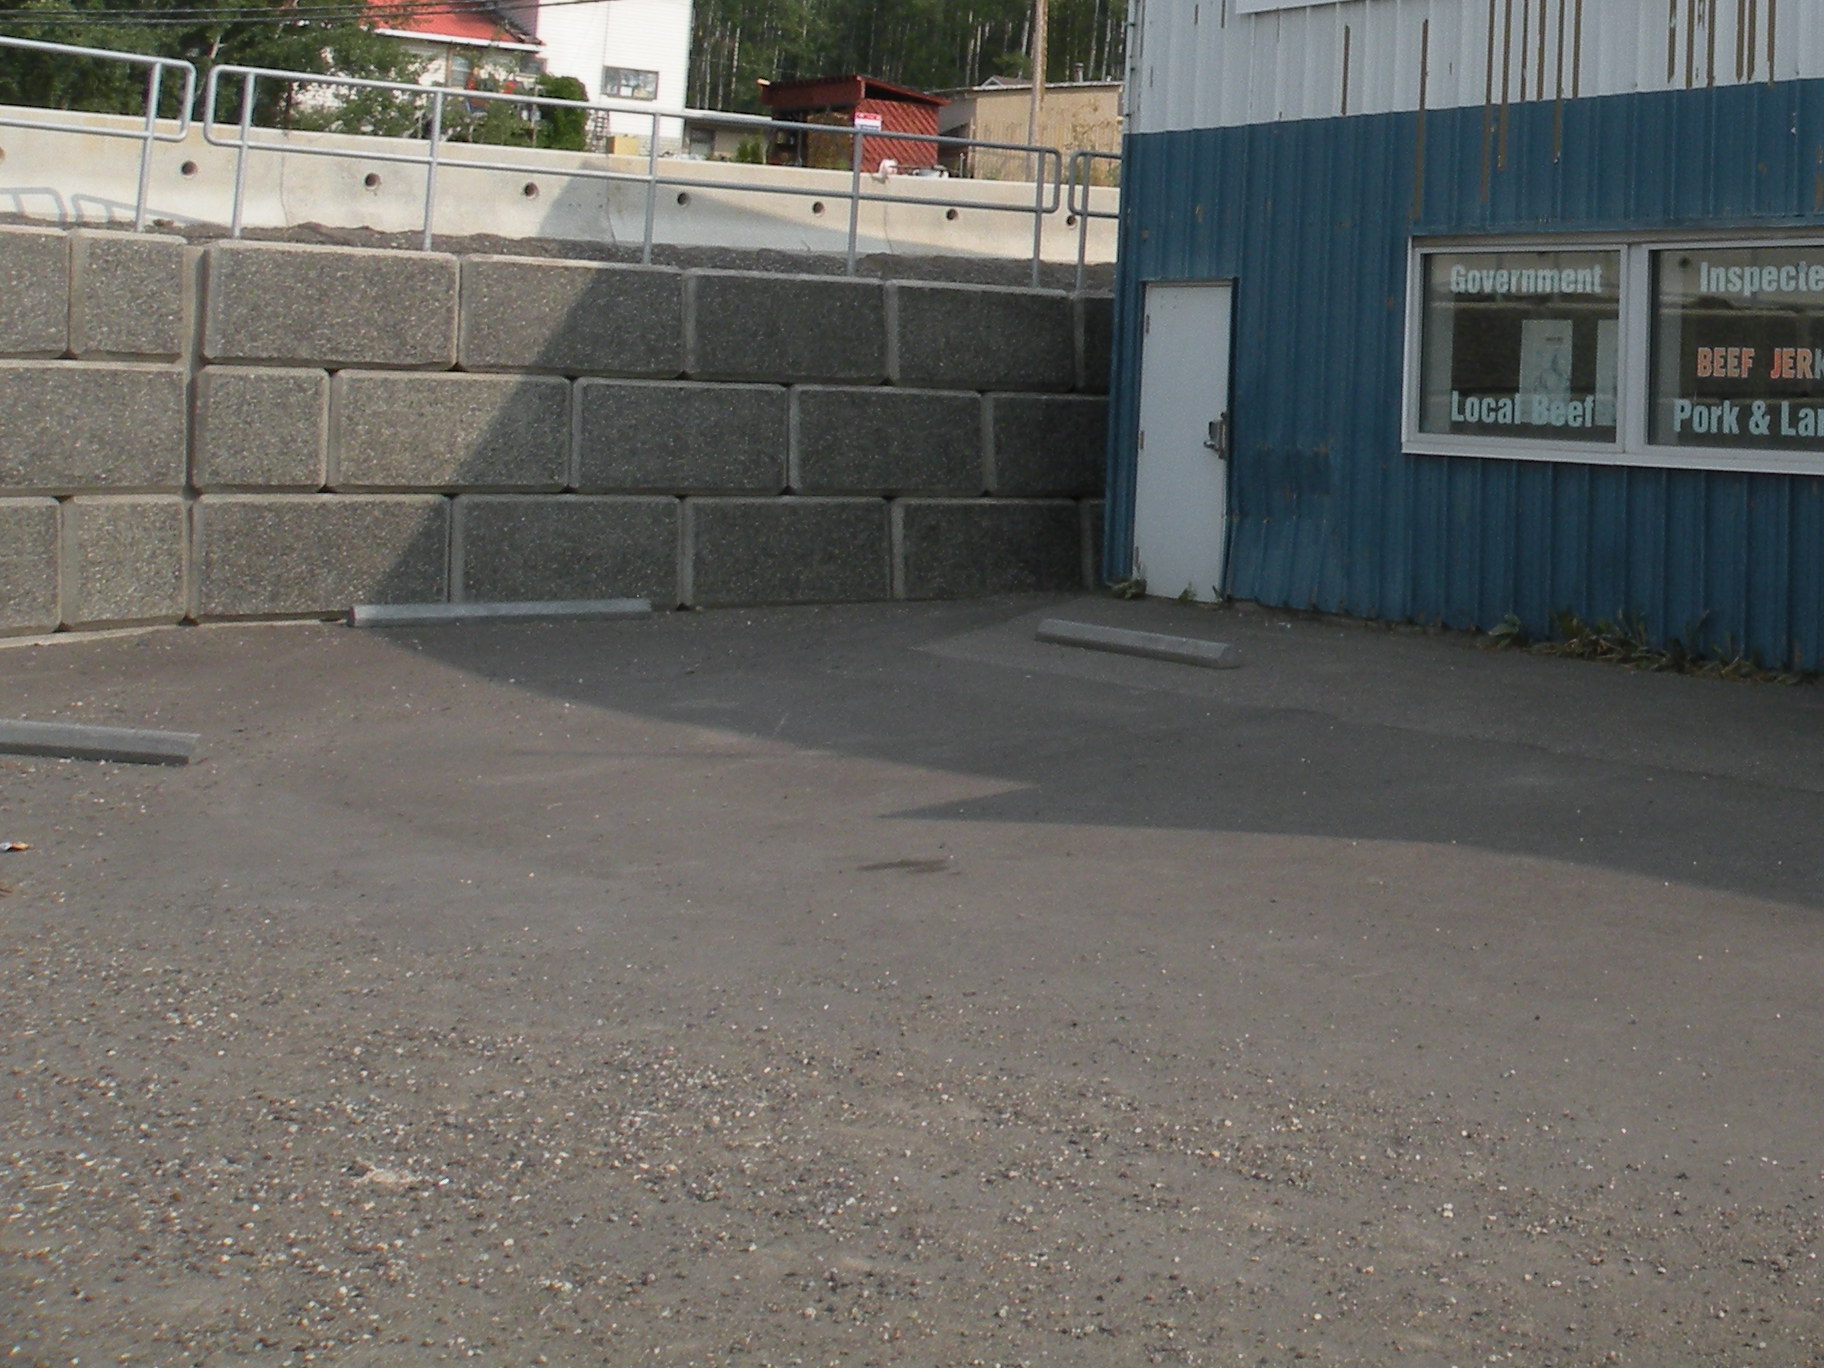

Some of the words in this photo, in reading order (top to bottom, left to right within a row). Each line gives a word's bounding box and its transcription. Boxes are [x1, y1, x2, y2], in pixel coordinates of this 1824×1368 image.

[1450, 263, 1603, 295] Government
[1696, 347, 1755, 380] BEEF
[1450, 390, 1523, 426] Local
[1530, 394, 1596, 429] Beef
[1672, 398, 1741, 436] Pork
[1748, 400, 1771, 436] &
